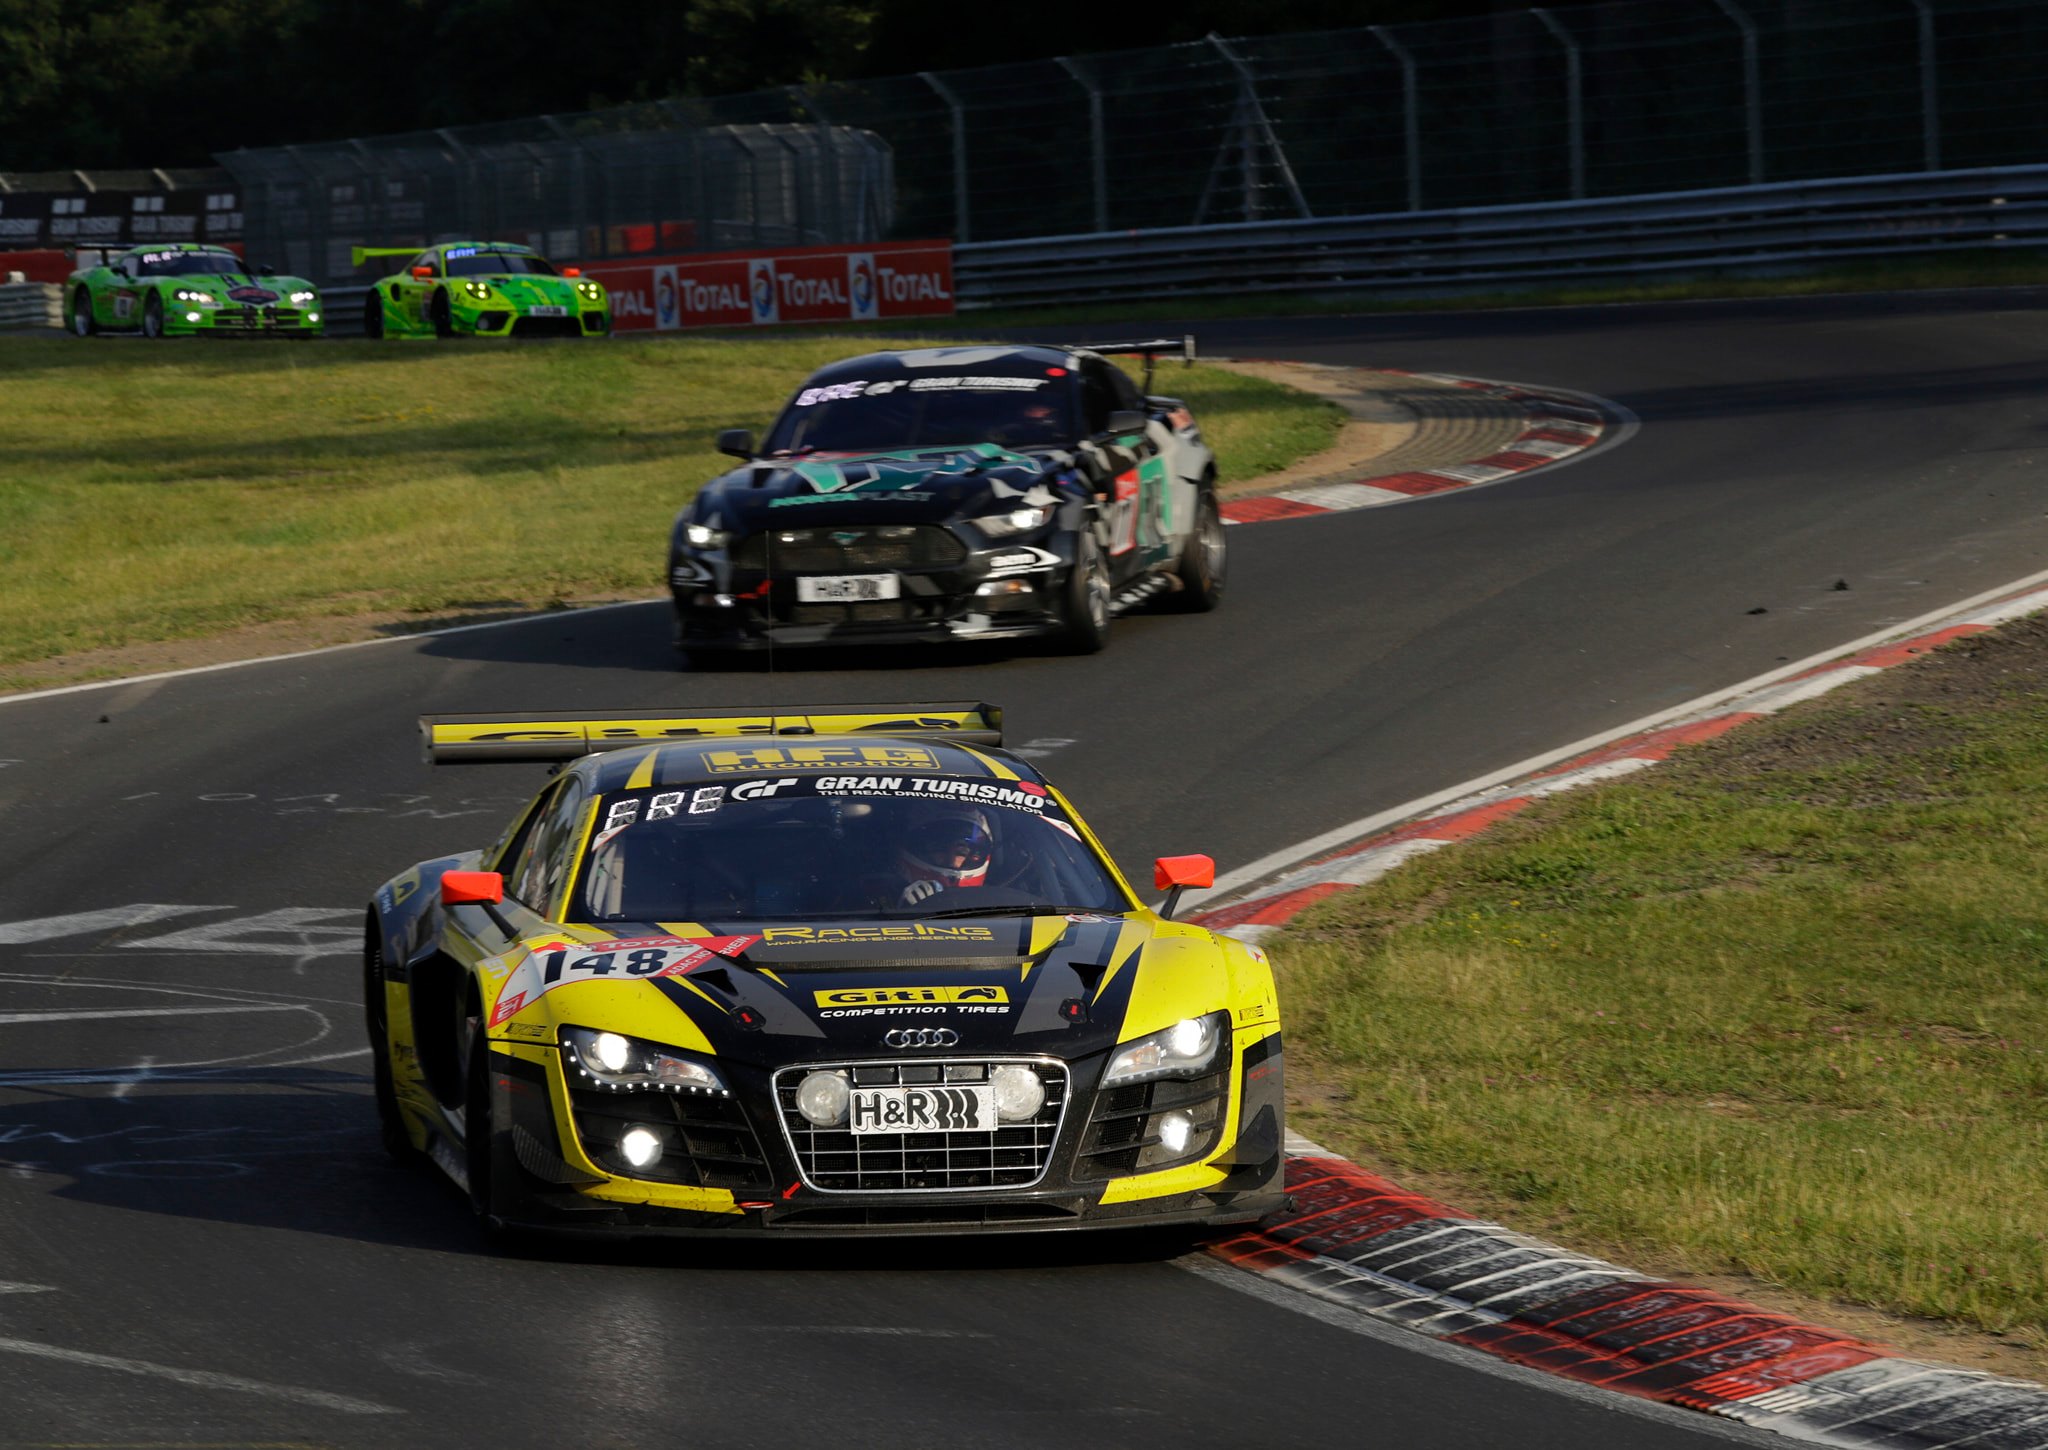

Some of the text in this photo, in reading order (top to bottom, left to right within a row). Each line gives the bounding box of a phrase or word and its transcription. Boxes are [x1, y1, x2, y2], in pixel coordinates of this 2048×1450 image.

[778, 272, 849, 306] TOTAL
[878, 267, 950, 299] TOTAL
[680, 278, 749, 312] TOTAL
[709, 747, 930, 766] HFG
[714, 760, 935, 772] automotive
[814, 776, 902, 790] GRAN
[854, 789, 894, 797] REAL
[894, 790, 952, 801] DRIVING
[960, 795, 1044, 816] SIMULATOR
[543, 948, 669, 985] 148
[666, 956, 699, 976] ADAC
[828, 989, 936, 1003] Giti
[819, 1005, 1010, 1018] COMPETITION TIRES
[853, 1091, 935, 1130] H&R
